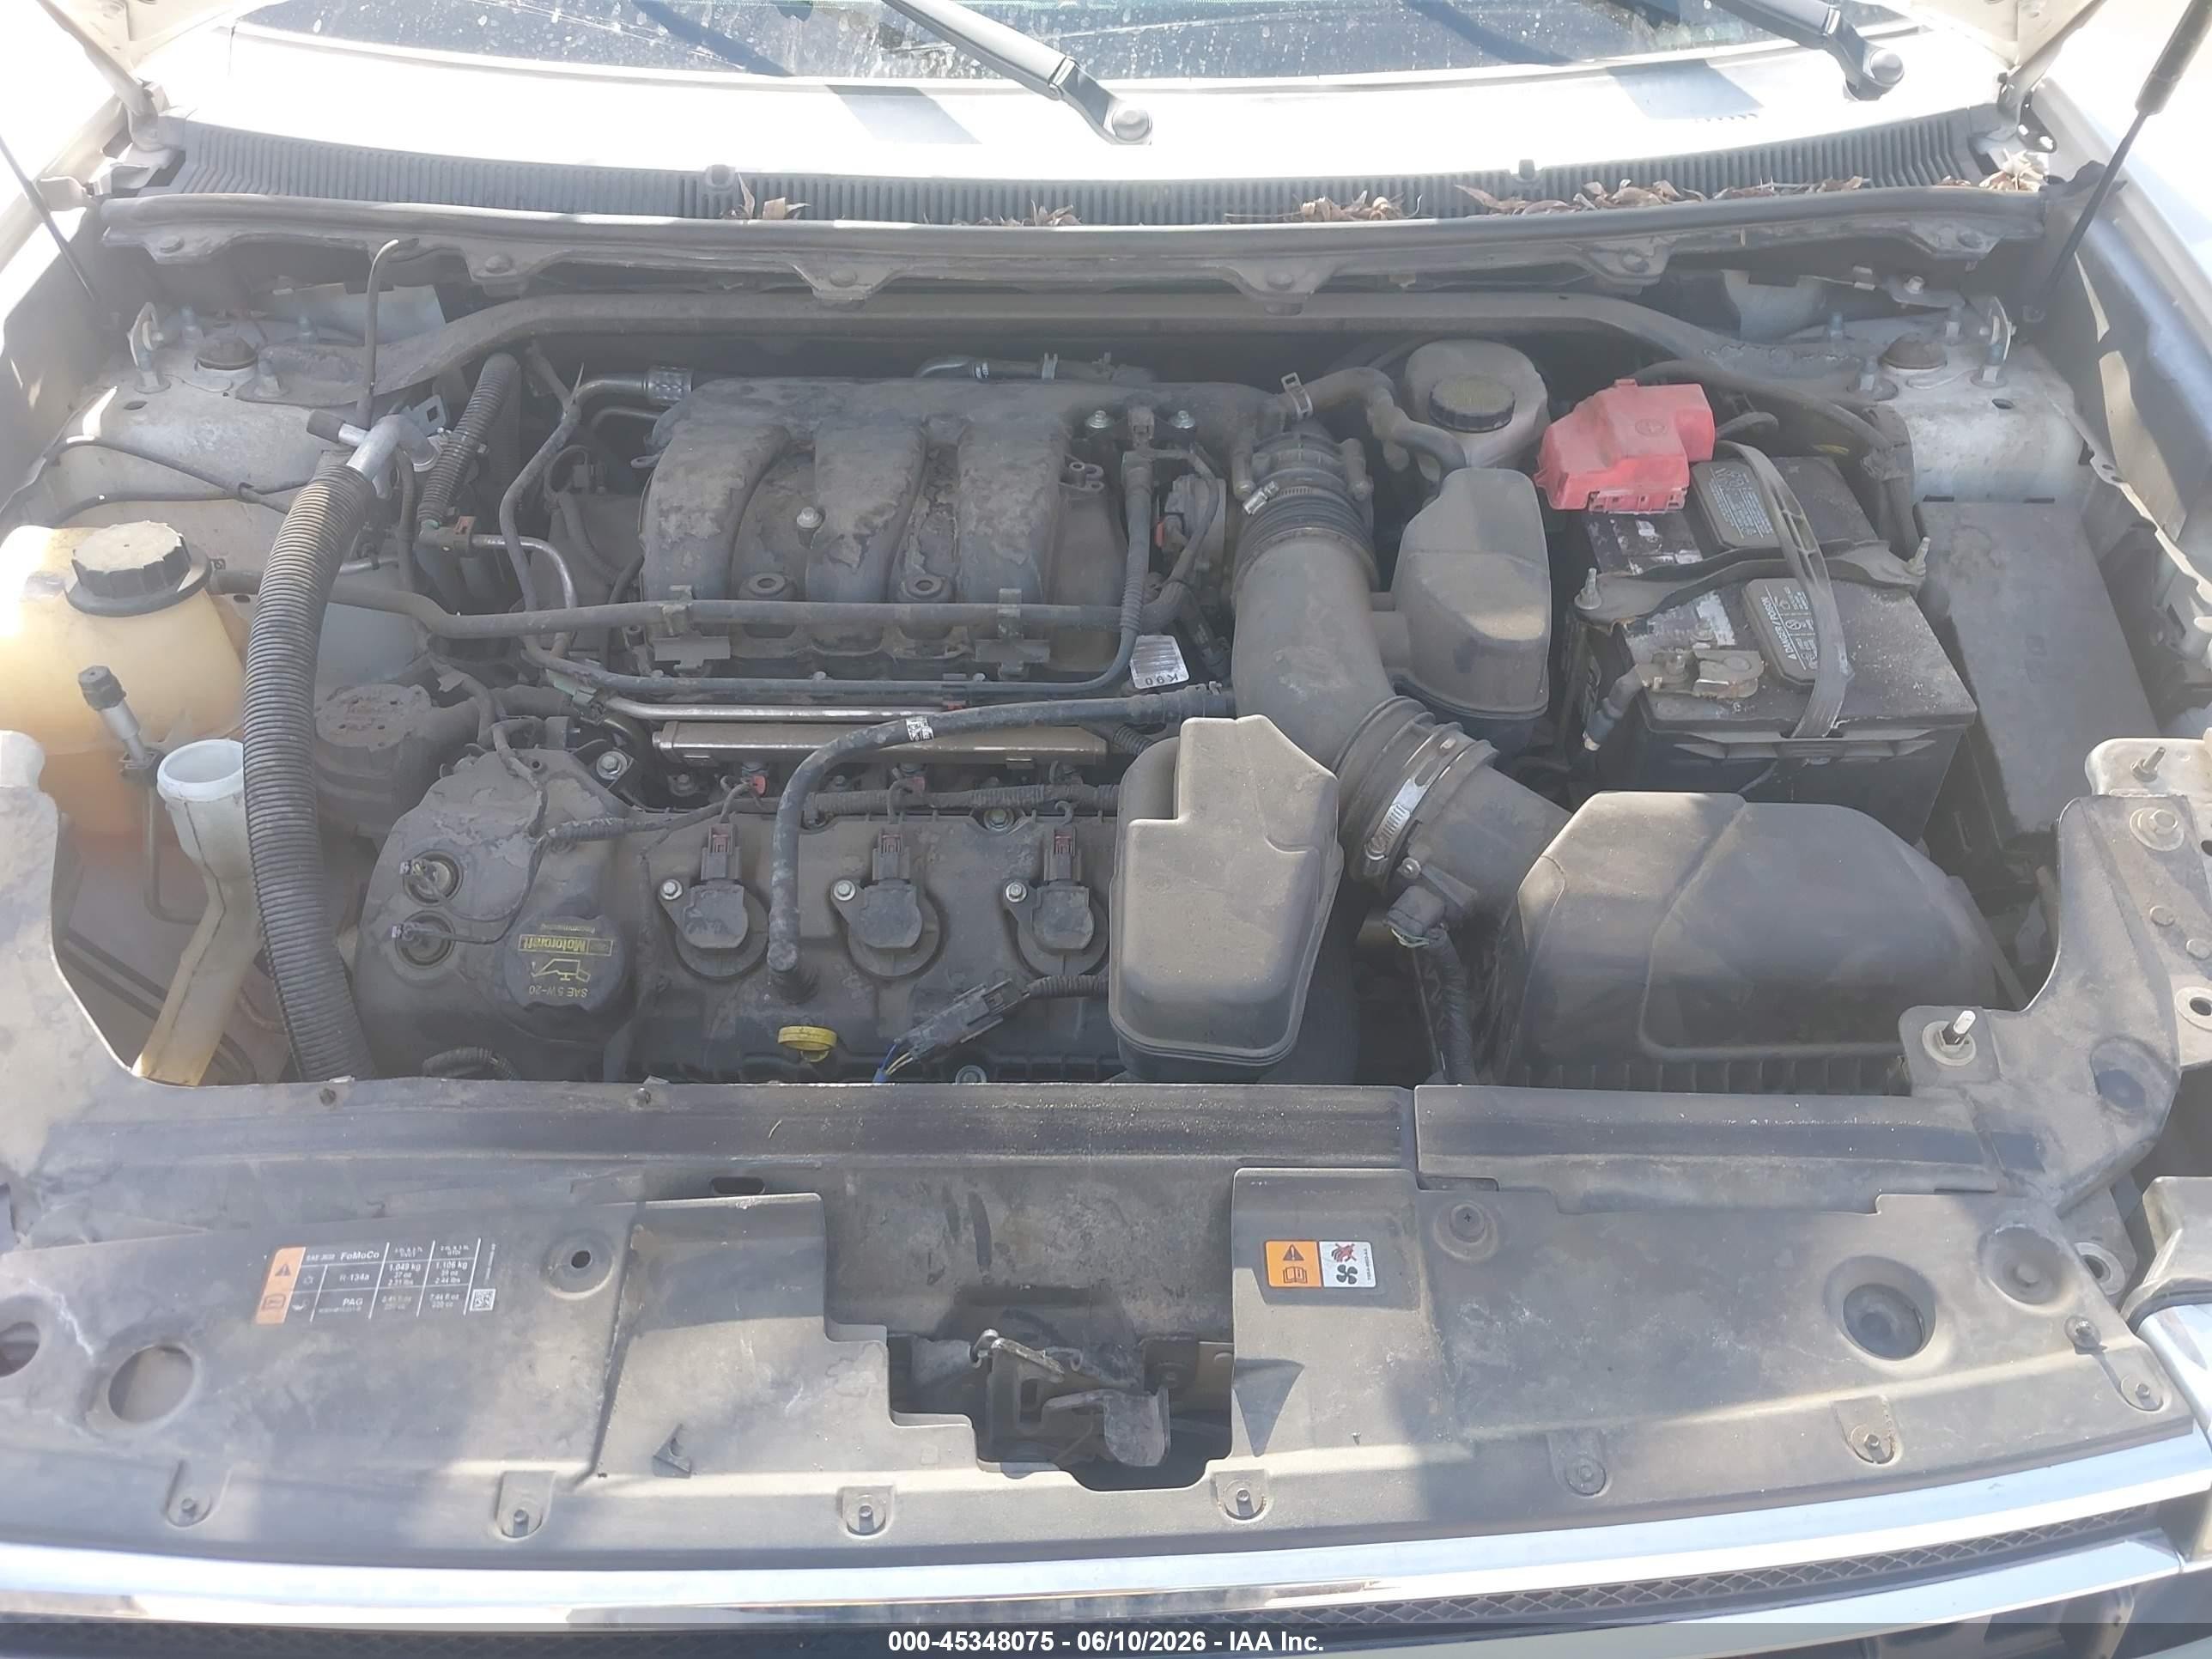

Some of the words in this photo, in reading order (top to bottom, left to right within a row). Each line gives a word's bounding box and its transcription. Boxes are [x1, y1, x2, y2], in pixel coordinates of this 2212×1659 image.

[523, 937, 586, 952] Motorcraft
[566, 987, 589, 998] SAE
[340, 1250, 380, 1261] FoMoCo
[389, 1262, 410, 1272] 1.049
[411, 1263, 421, 1272] kg
[435, 1261, 456, 1270] 1.106
[458, 1261, 468, 1270] kg
[339, 1273, 370, 1282] R-134a
[343, 1297, 363, 1306] PAG
